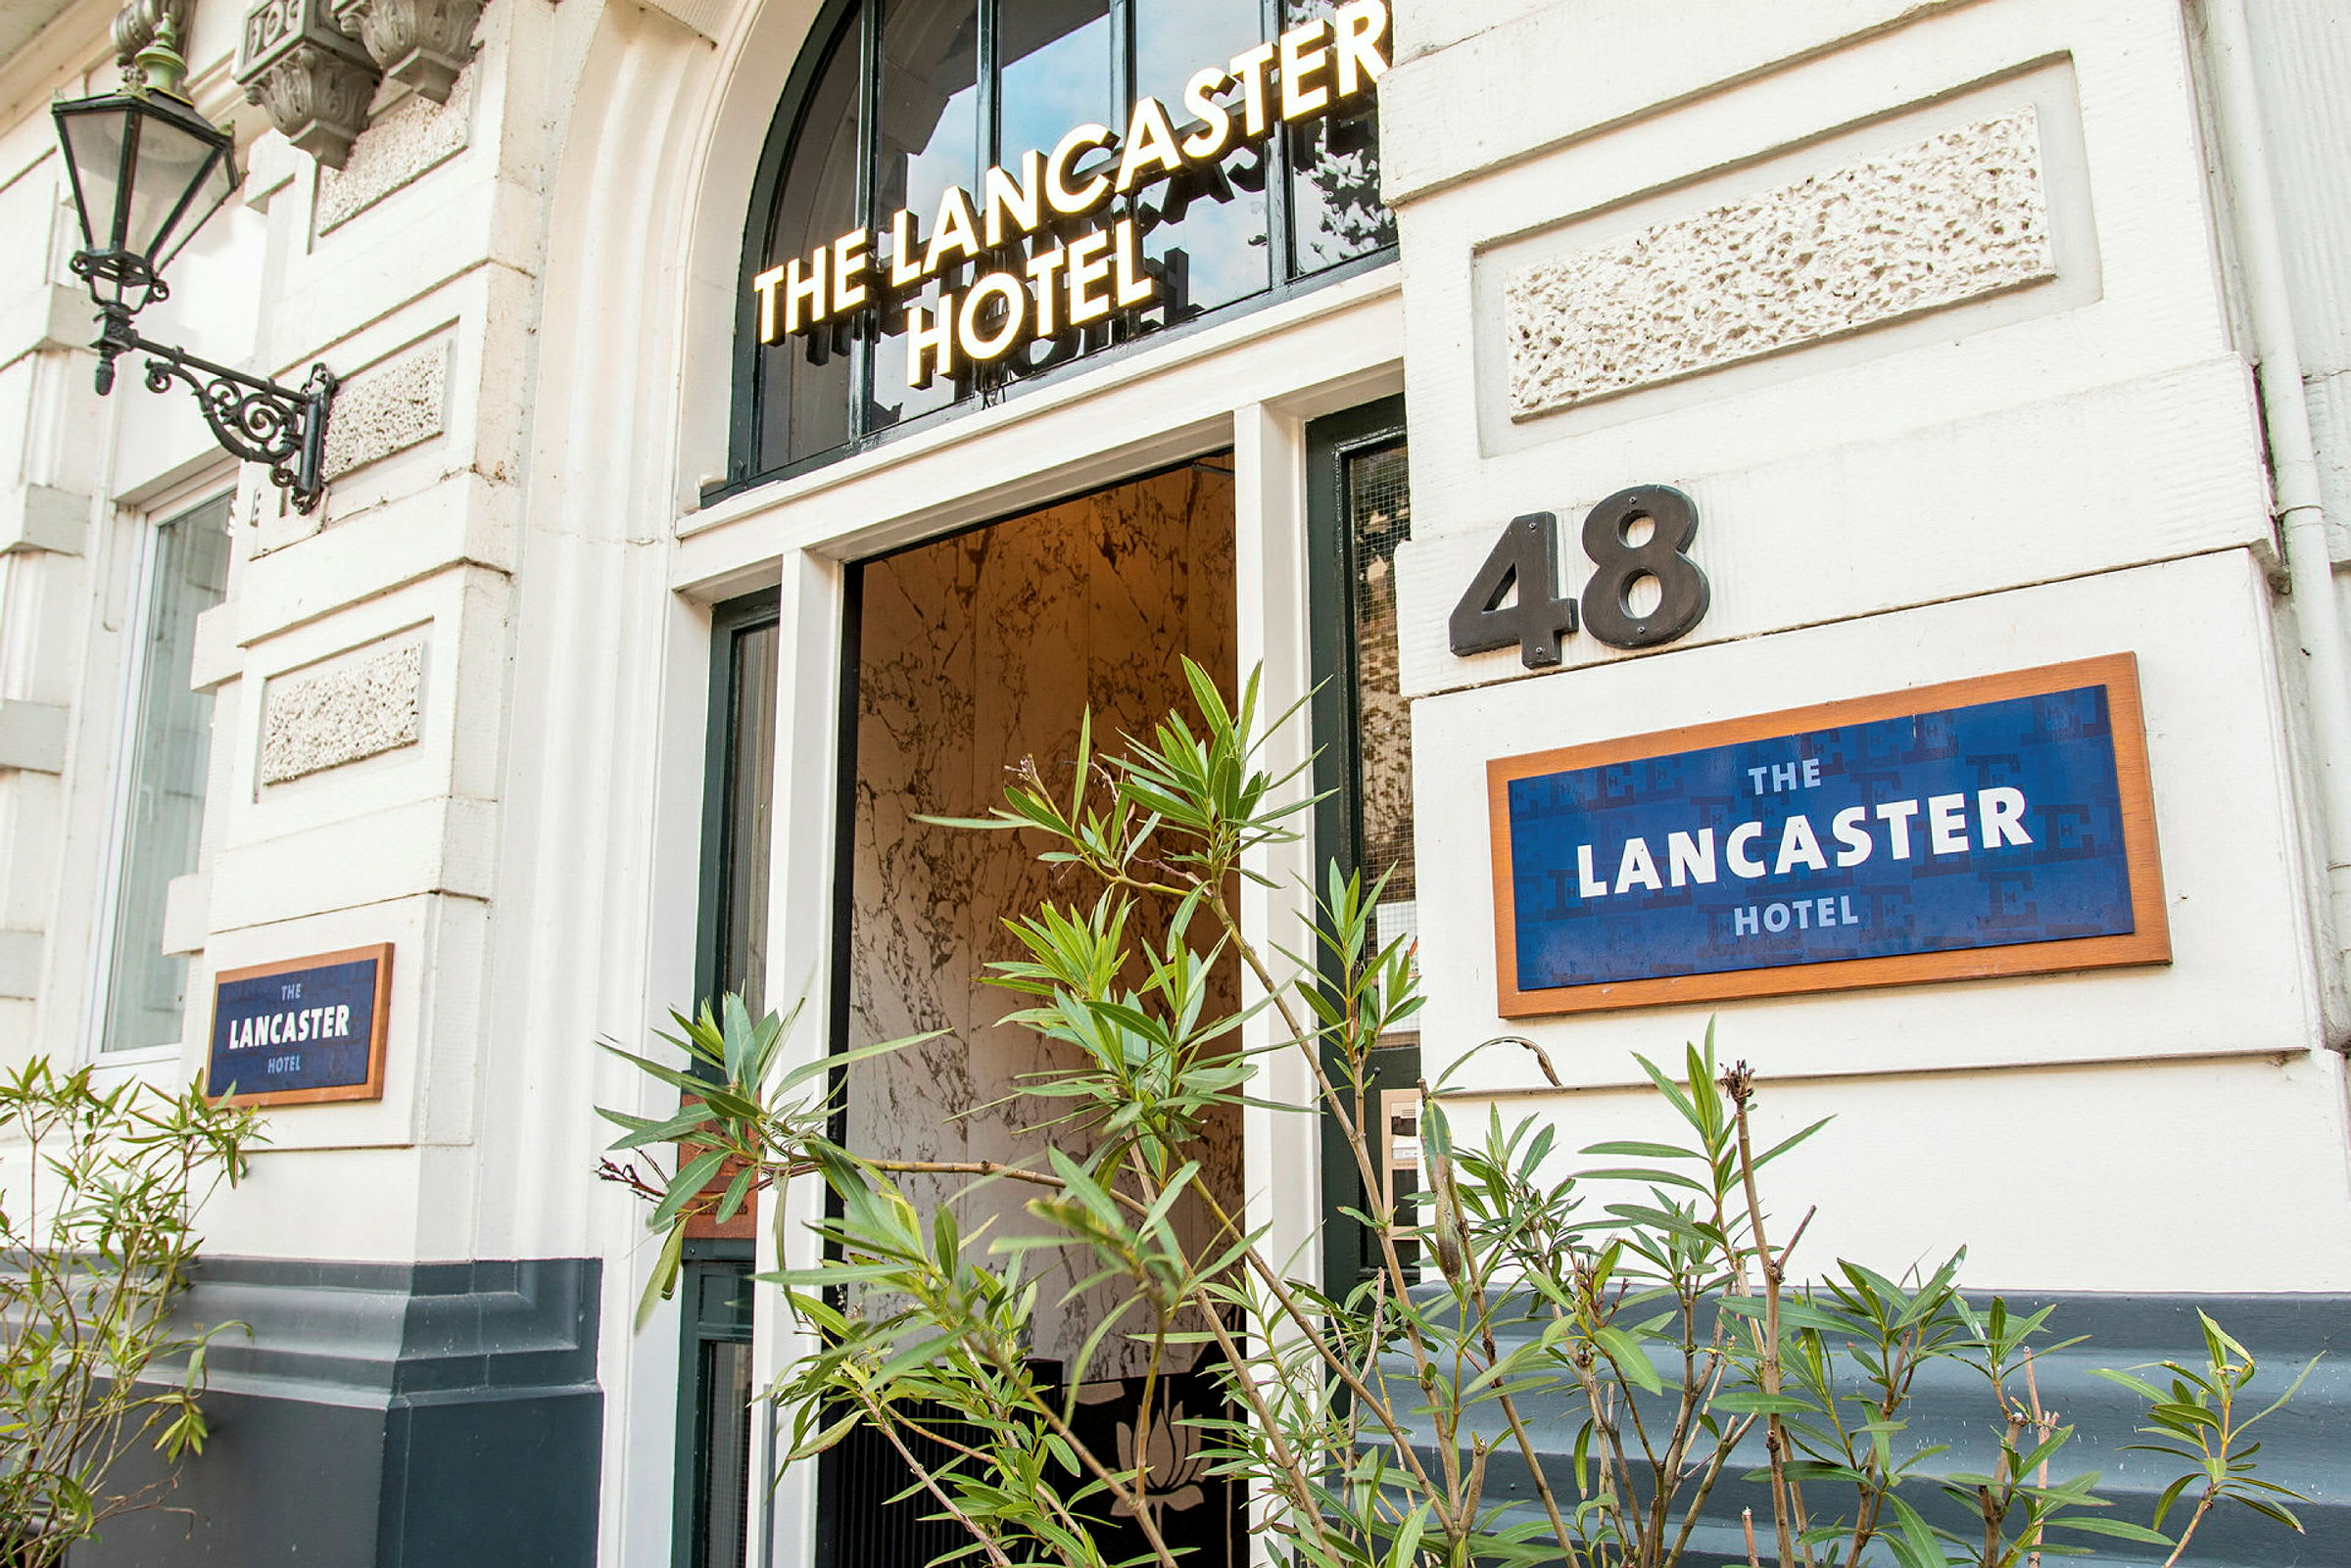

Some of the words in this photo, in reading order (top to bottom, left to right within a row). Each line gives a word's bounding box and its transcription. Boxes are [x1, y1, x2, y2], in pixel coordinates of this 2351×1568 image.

[753, 226, 870, 345] THE
[890, 0, 1389, 289] LANCASTER
[907, 218, 1156, 388] HOTEL
[1449, 484, 1710, 669] 48
[1748, 758, 1821, 795] THE
[1577, 786, 2034, 898] LANCASTER
[1733, 895, 1859, 936] HOTEL
[281, 983, 302, 1001] THE
[228, 1004, 351, 1050] LANCASTER
[267, 1056, 301, 1074] HOTEL
